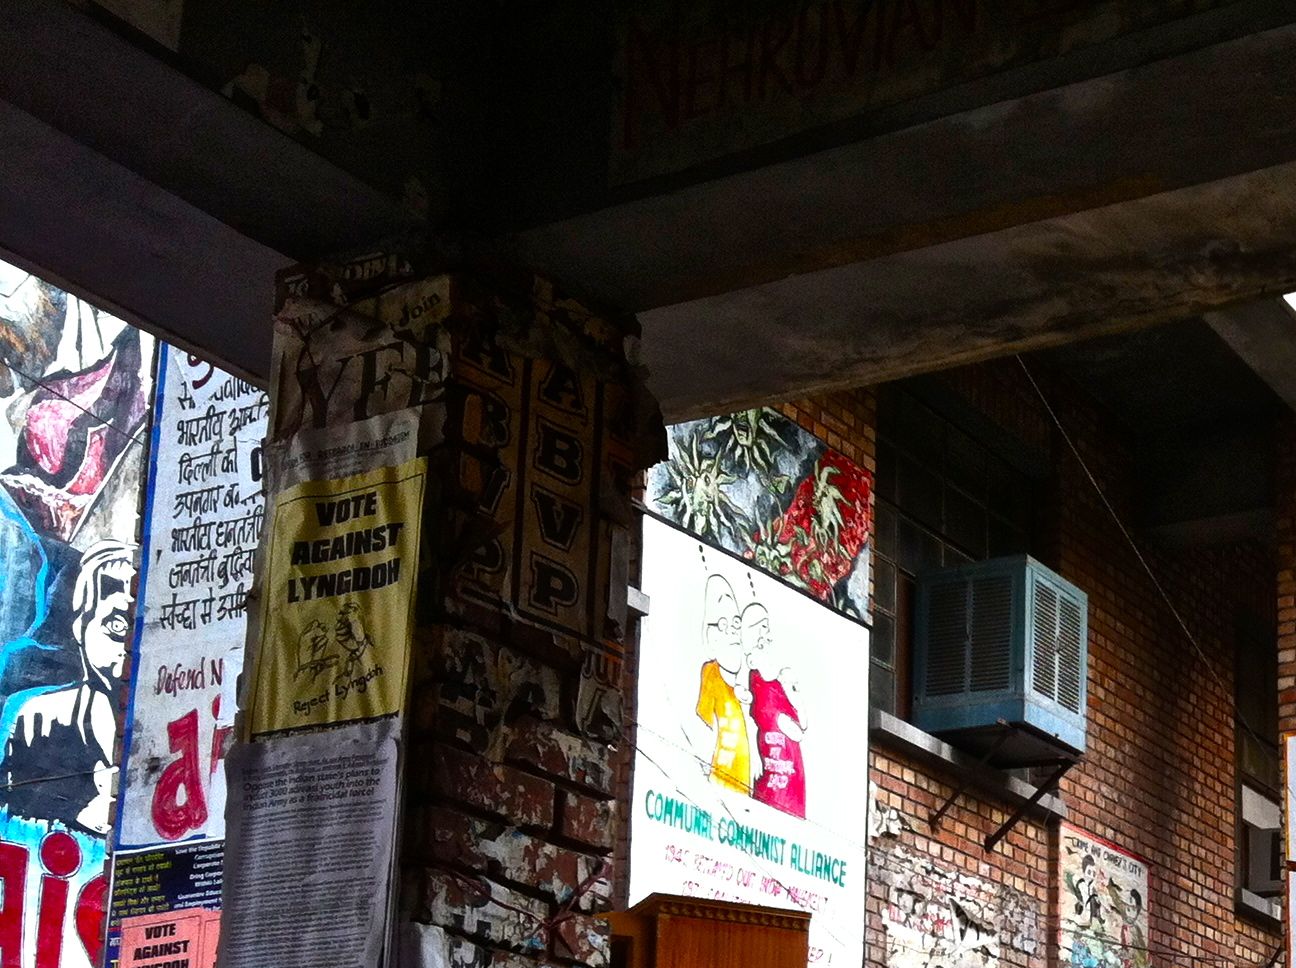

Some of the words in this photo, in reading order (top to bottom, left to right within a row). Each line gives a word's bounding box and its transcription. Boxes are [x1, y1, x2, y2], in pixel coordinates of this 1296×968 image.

[398, 292, 441, 327] Join
[178, 443, 223, 485] दिल्ली
[528, 357, 589, 617] ABVP
[315, 490, 378, 527] VOTE
[291, 522, 404, 566] AGAINST
[288, 558, 401, 603] LYNGDOH
[155, 657, 205, 696] Defend
[293, 690, 329, 716] Reject
[335, 664, 383, 700] Lyngdoh
[320, 781, 345, 792] youth
[346, 779, 364, 788] into
[366, 777, 380, 786] the
[346, 769, 369, 780] plans
[790, 843, 847, 887] ALLIANCE
[133, 940, 190, 961] AGAINST
[145, 924, 176, 940] VOTE
